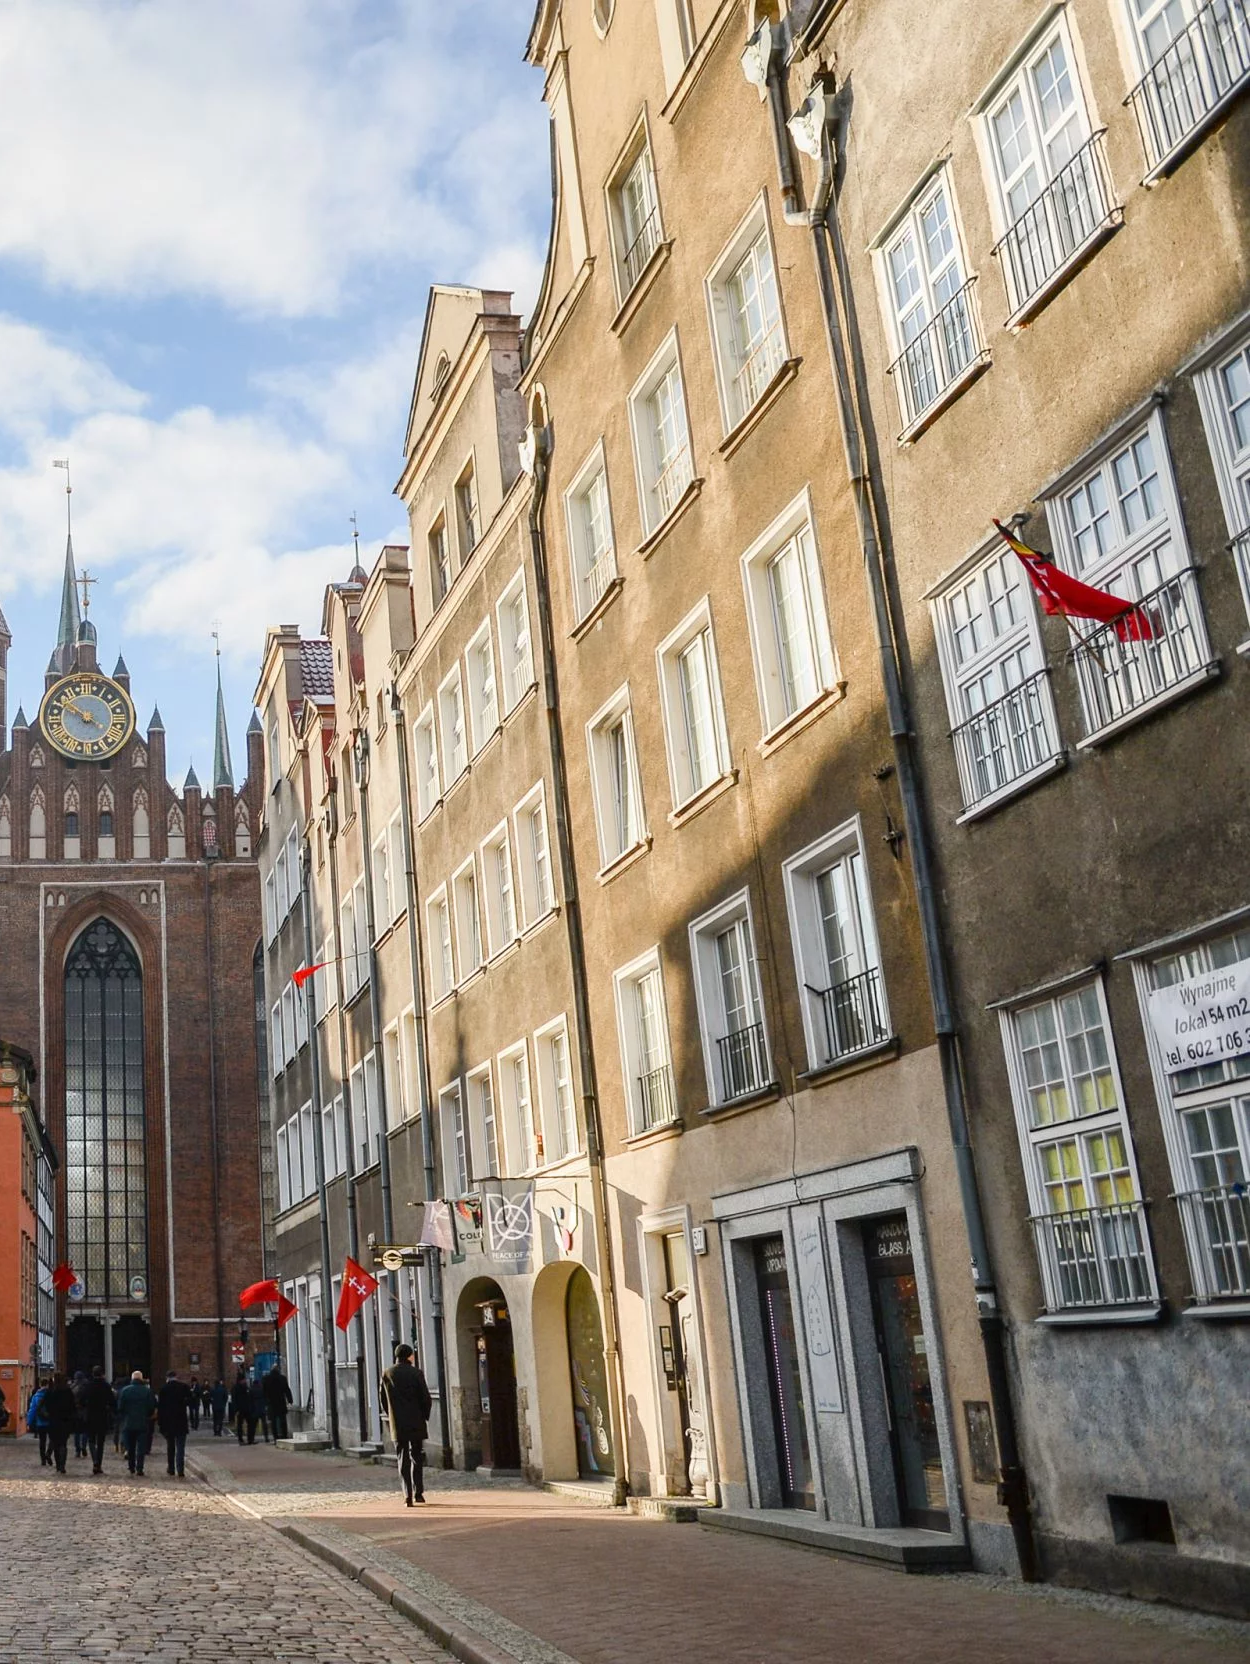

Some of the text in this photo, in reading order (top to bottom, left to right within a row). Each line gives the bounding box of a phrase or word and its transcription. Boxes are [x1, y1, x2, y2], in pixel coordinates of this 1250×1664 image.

[1179, 975, 1236, 1006] Wynajmę
[1175, 997, 1250, 1035] lokal 54 m2
[1166, 1046, 1186, 1066] tel.
[1187, 1039, 1213, 1060] 602
[878, 1241, 903, 1257] GLASS
